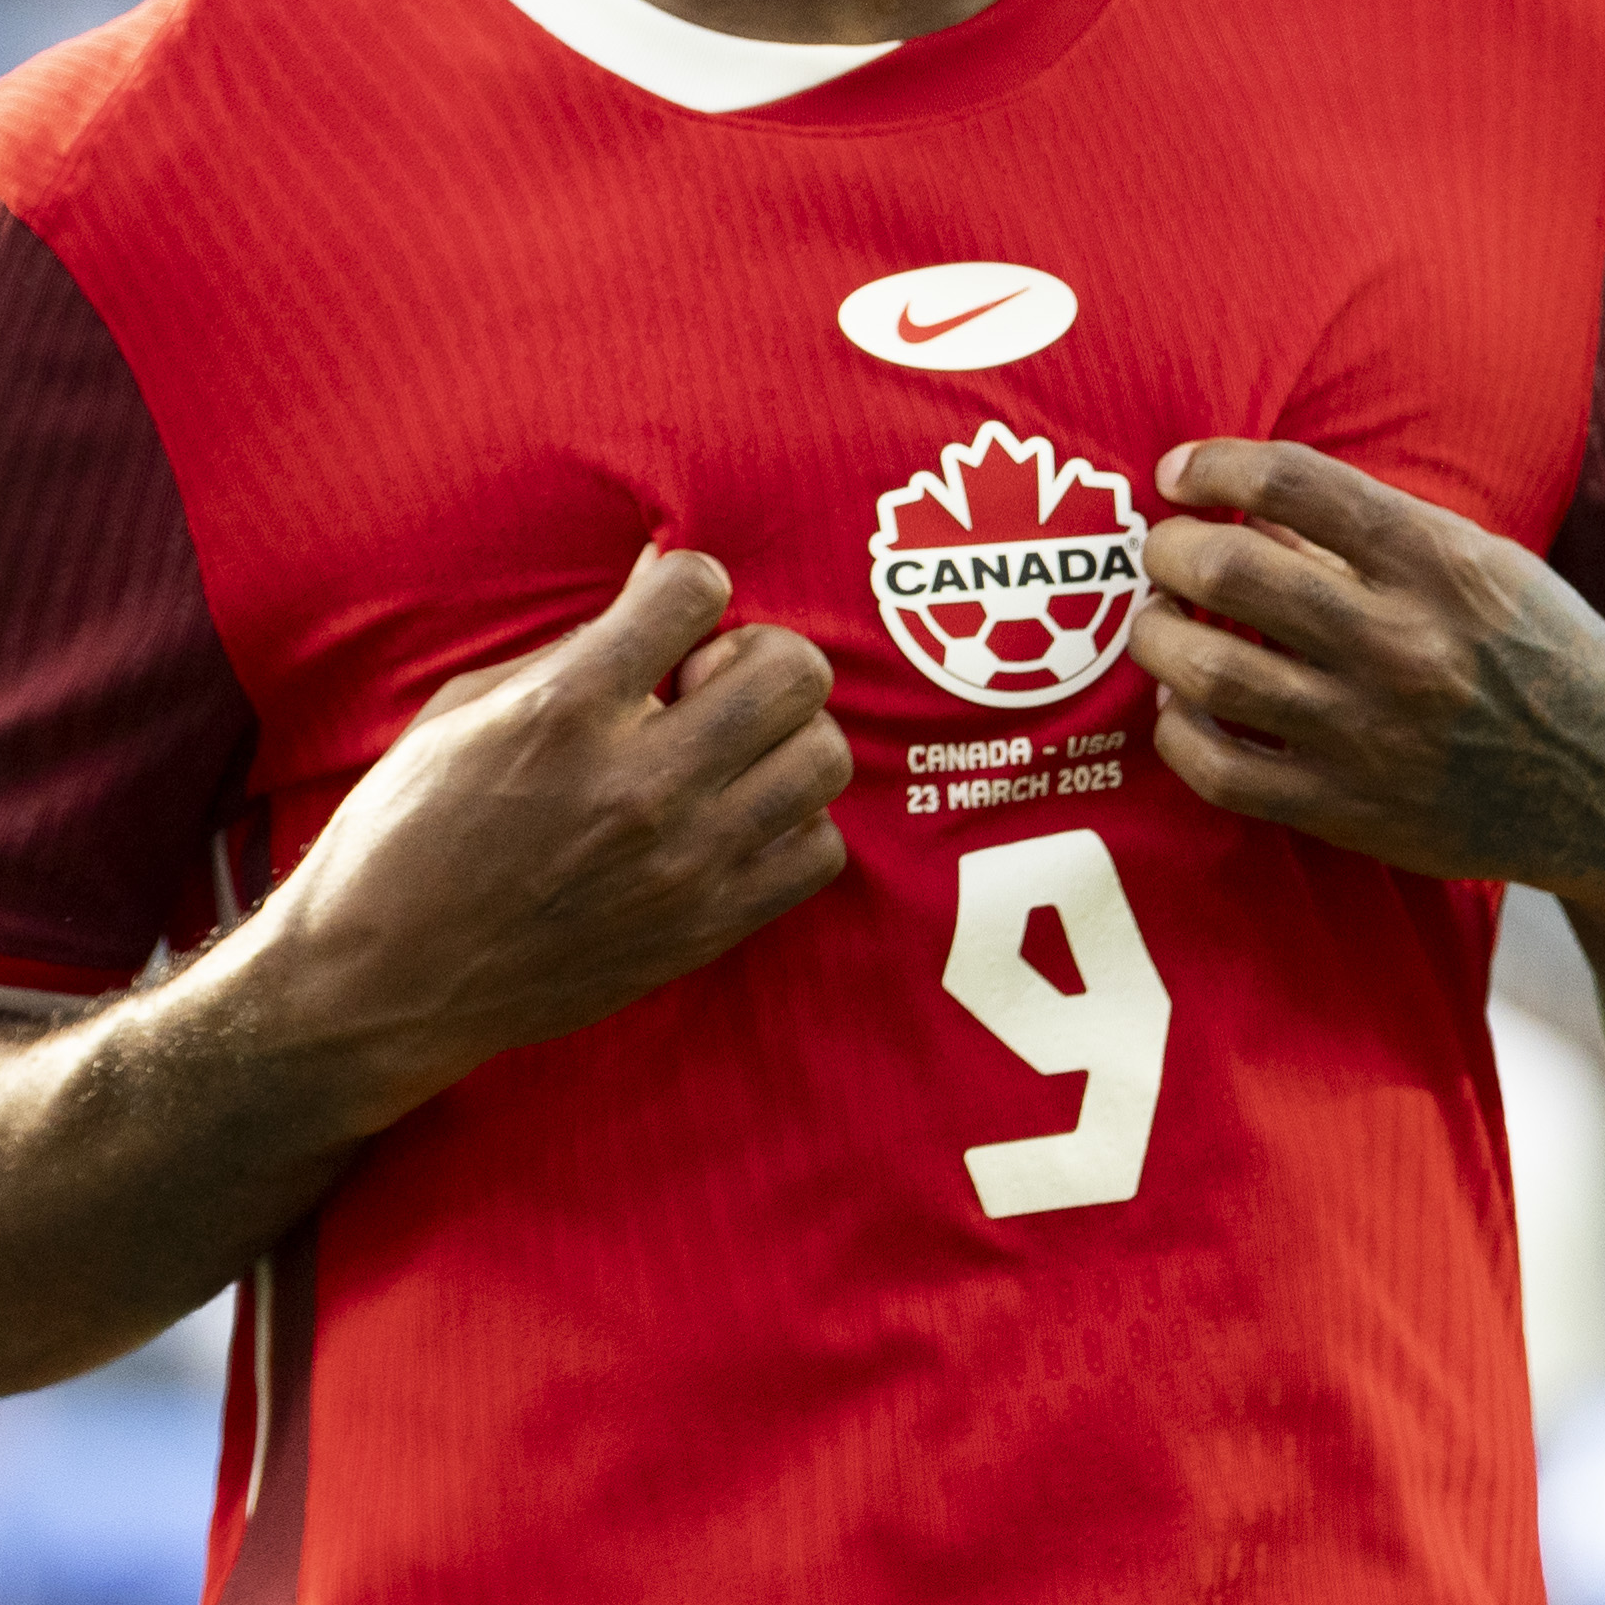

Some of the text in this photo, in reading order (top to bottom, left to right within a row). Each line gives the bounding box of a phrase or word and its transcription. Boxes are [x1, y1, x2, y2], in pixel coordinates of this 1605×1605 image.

[886, 545, 1138, 596] CANADA
[907, 736, 1033, 774] CANADA
[1066, 730, 1127, 759] USA
[906, 760, 1123, 815] 23 MARCH 2025
[942, 828, 1173, 1220] 9
